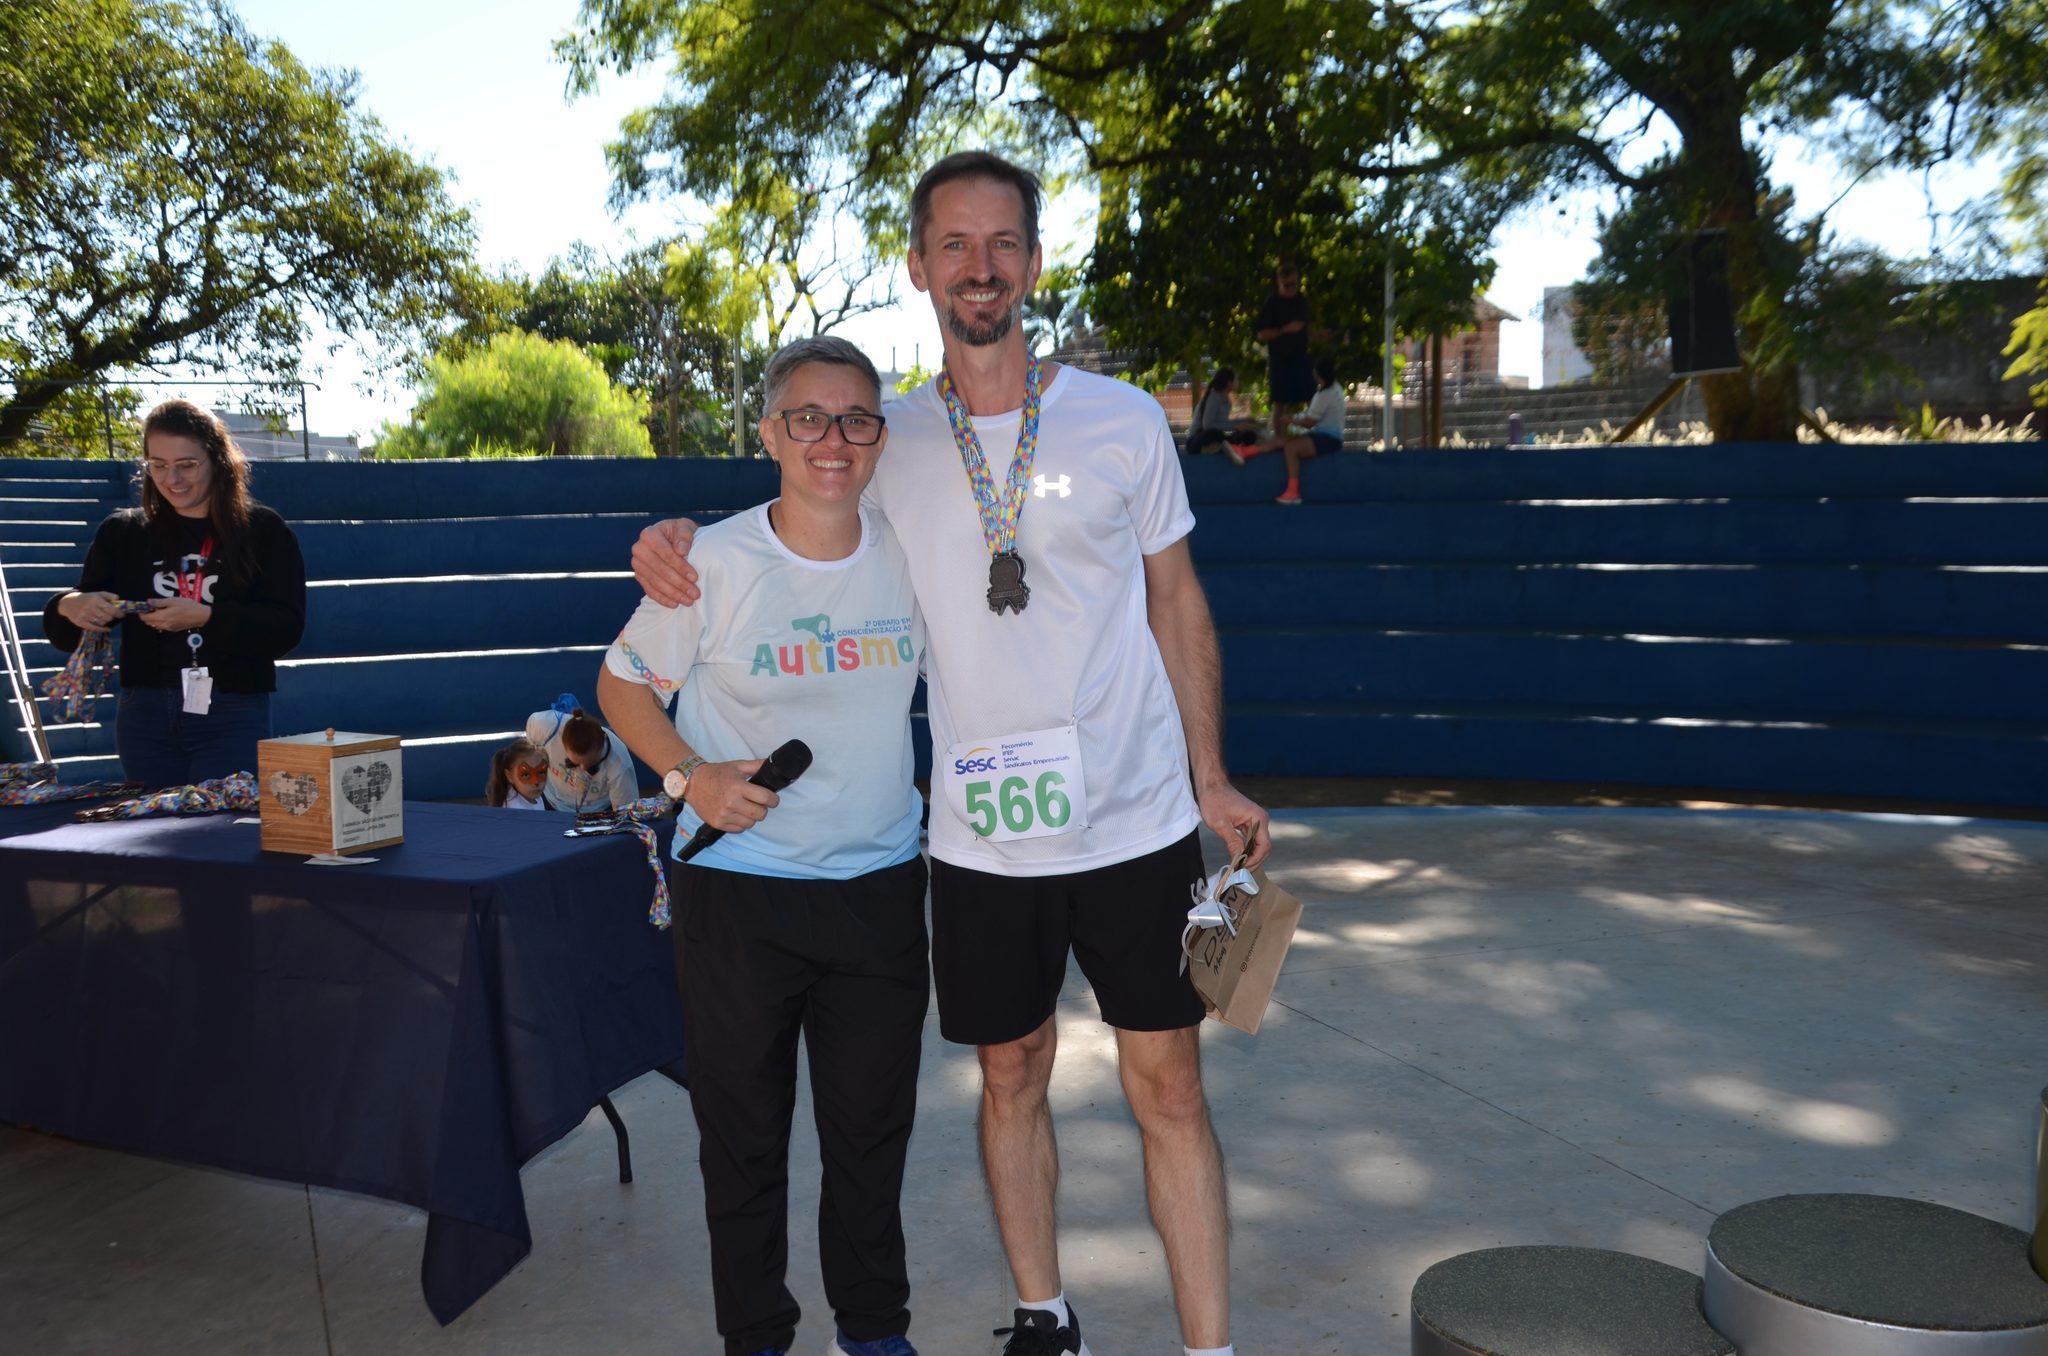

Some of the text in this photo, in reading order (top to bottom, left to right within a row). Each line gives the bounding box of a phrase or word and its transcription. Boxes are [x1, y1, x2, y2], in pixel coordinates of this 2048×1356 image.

[873, 618, 900, 627] DESAFIO
[901, 616, 910, 624] EM
[837, 626, 901, 637] CONSCIENTIZAÇÃO
[1004, 756, 1070, 769] Sindicatos Empresariais
[966, 771, 1071, 837] 566
